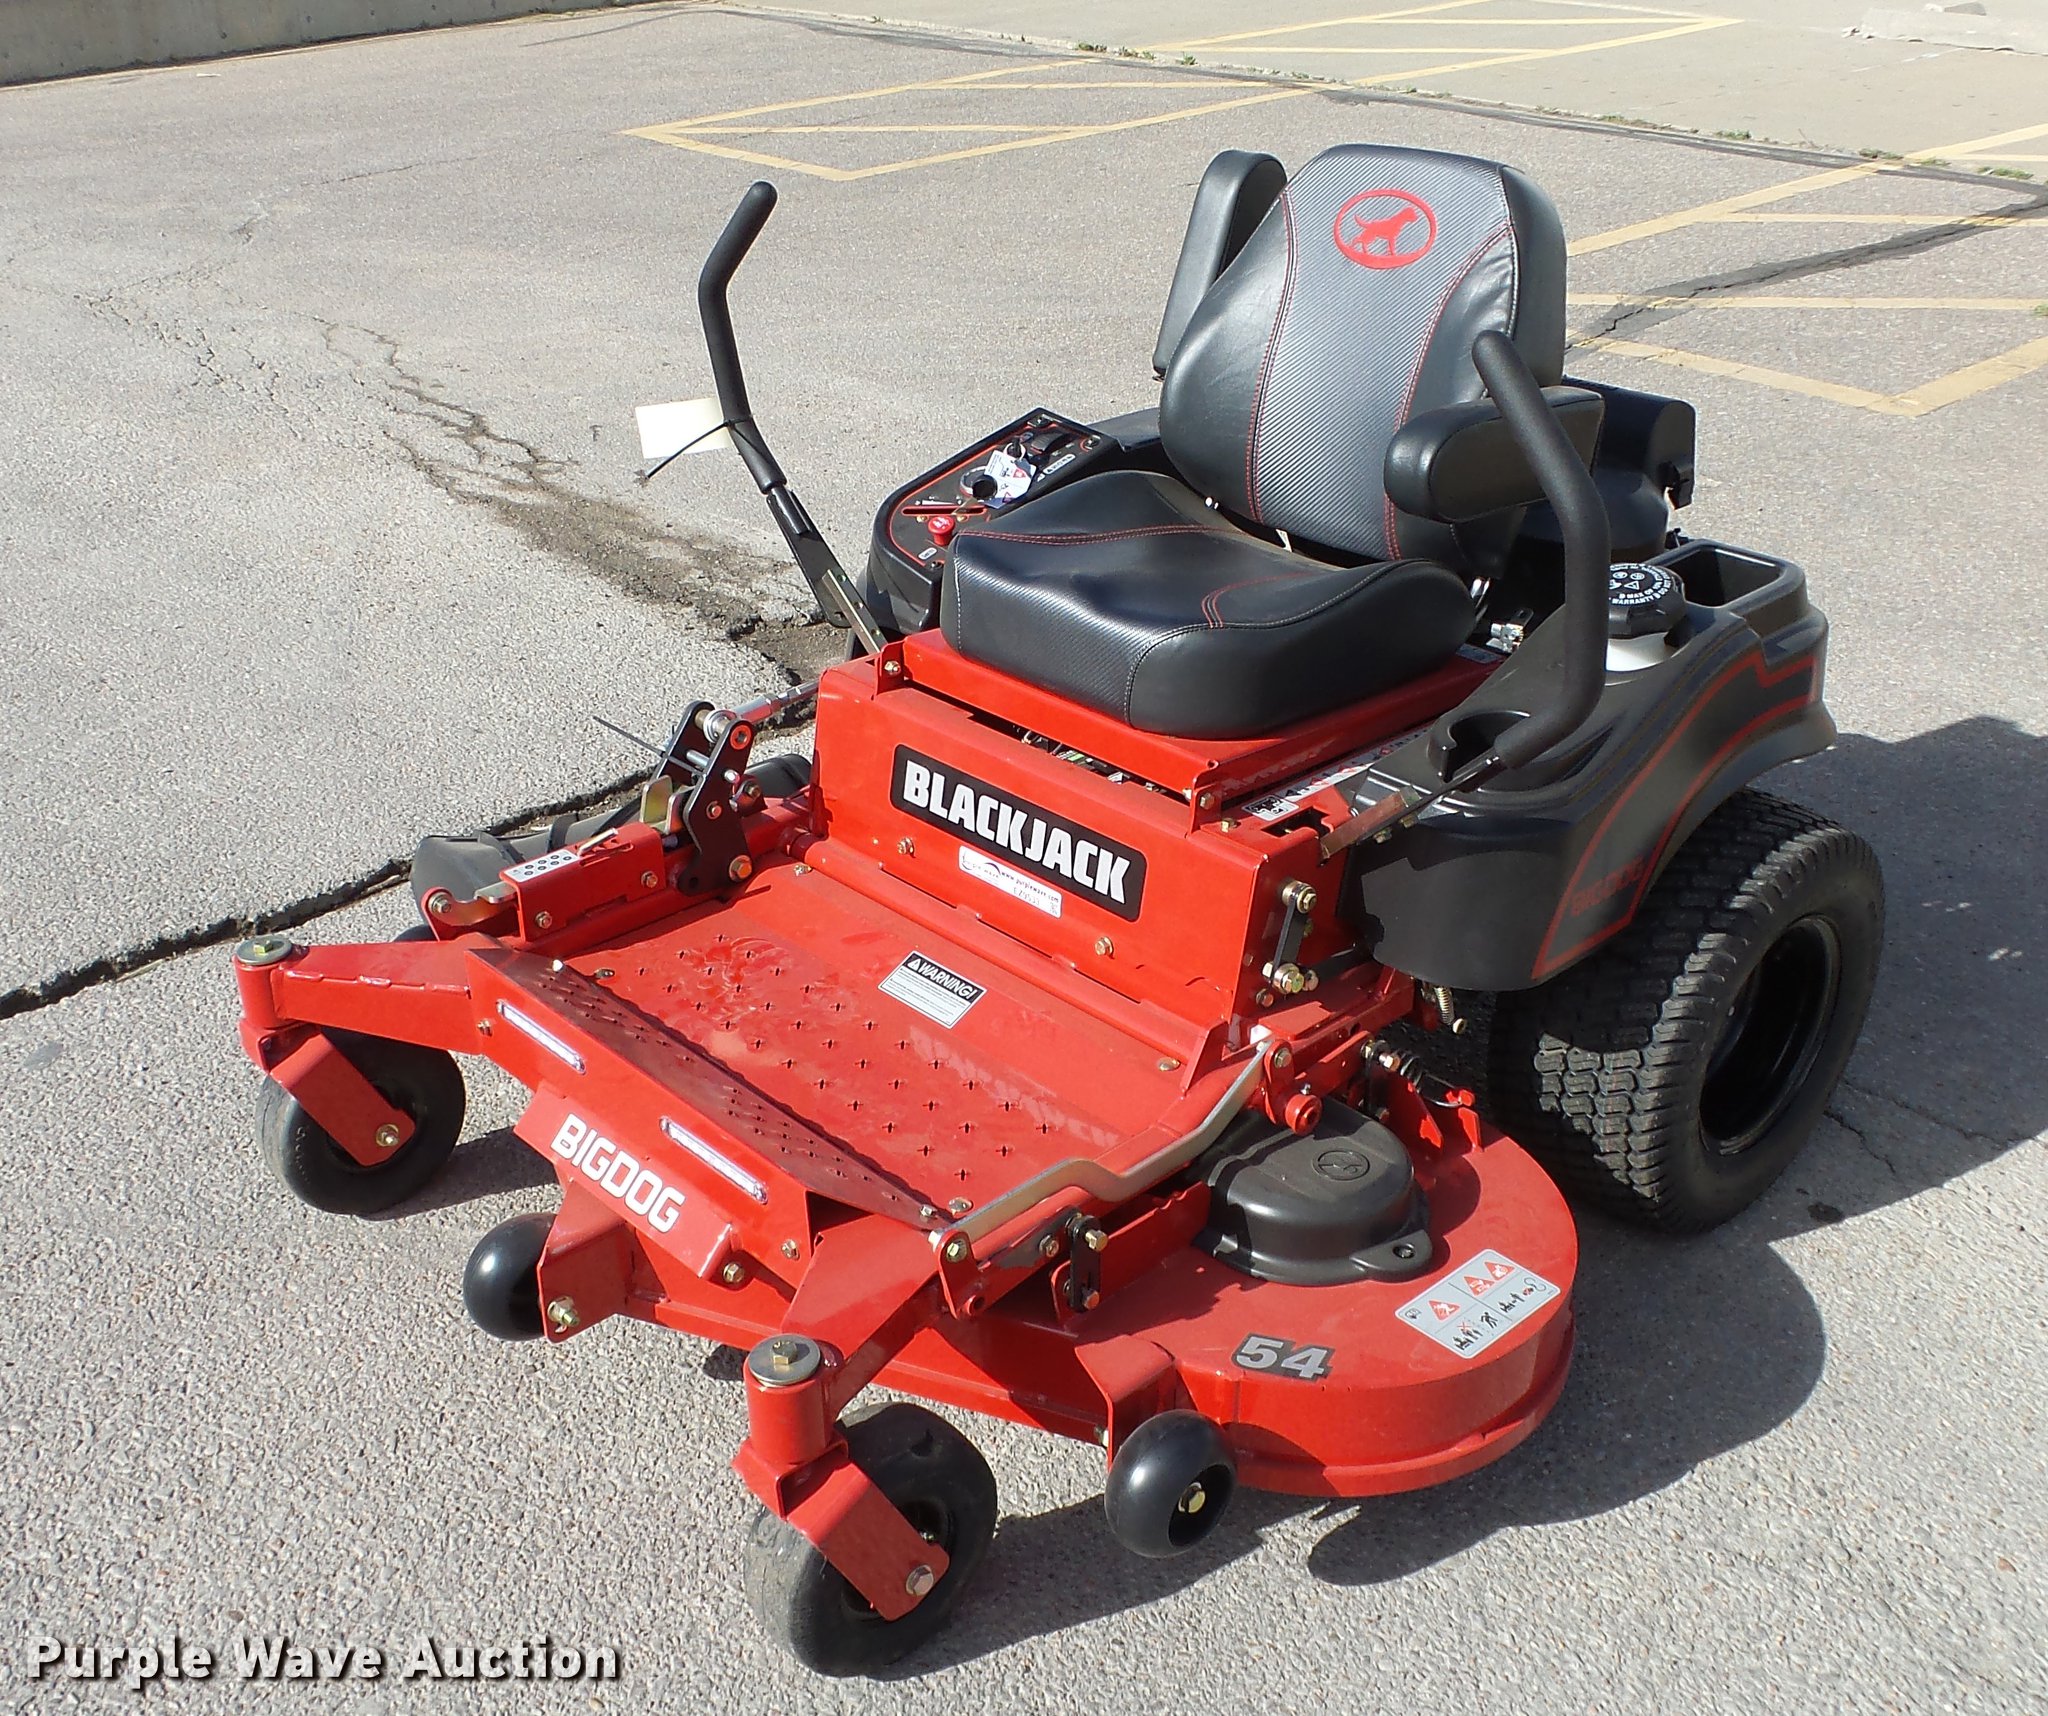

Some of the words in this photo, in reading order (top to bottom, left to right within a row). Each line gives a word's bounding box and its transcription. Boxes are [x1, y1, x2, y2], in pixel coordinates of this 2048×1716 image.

[1611, 594, 1655, 605] WARRANTY
[903, 760, 1131, 904] BLACKJACK
[918, 961, 979, 1000] WARNING!
[550, 1113, 687, 1233] BIGDOG
[1237, 1335, 1329, 1379] 54
